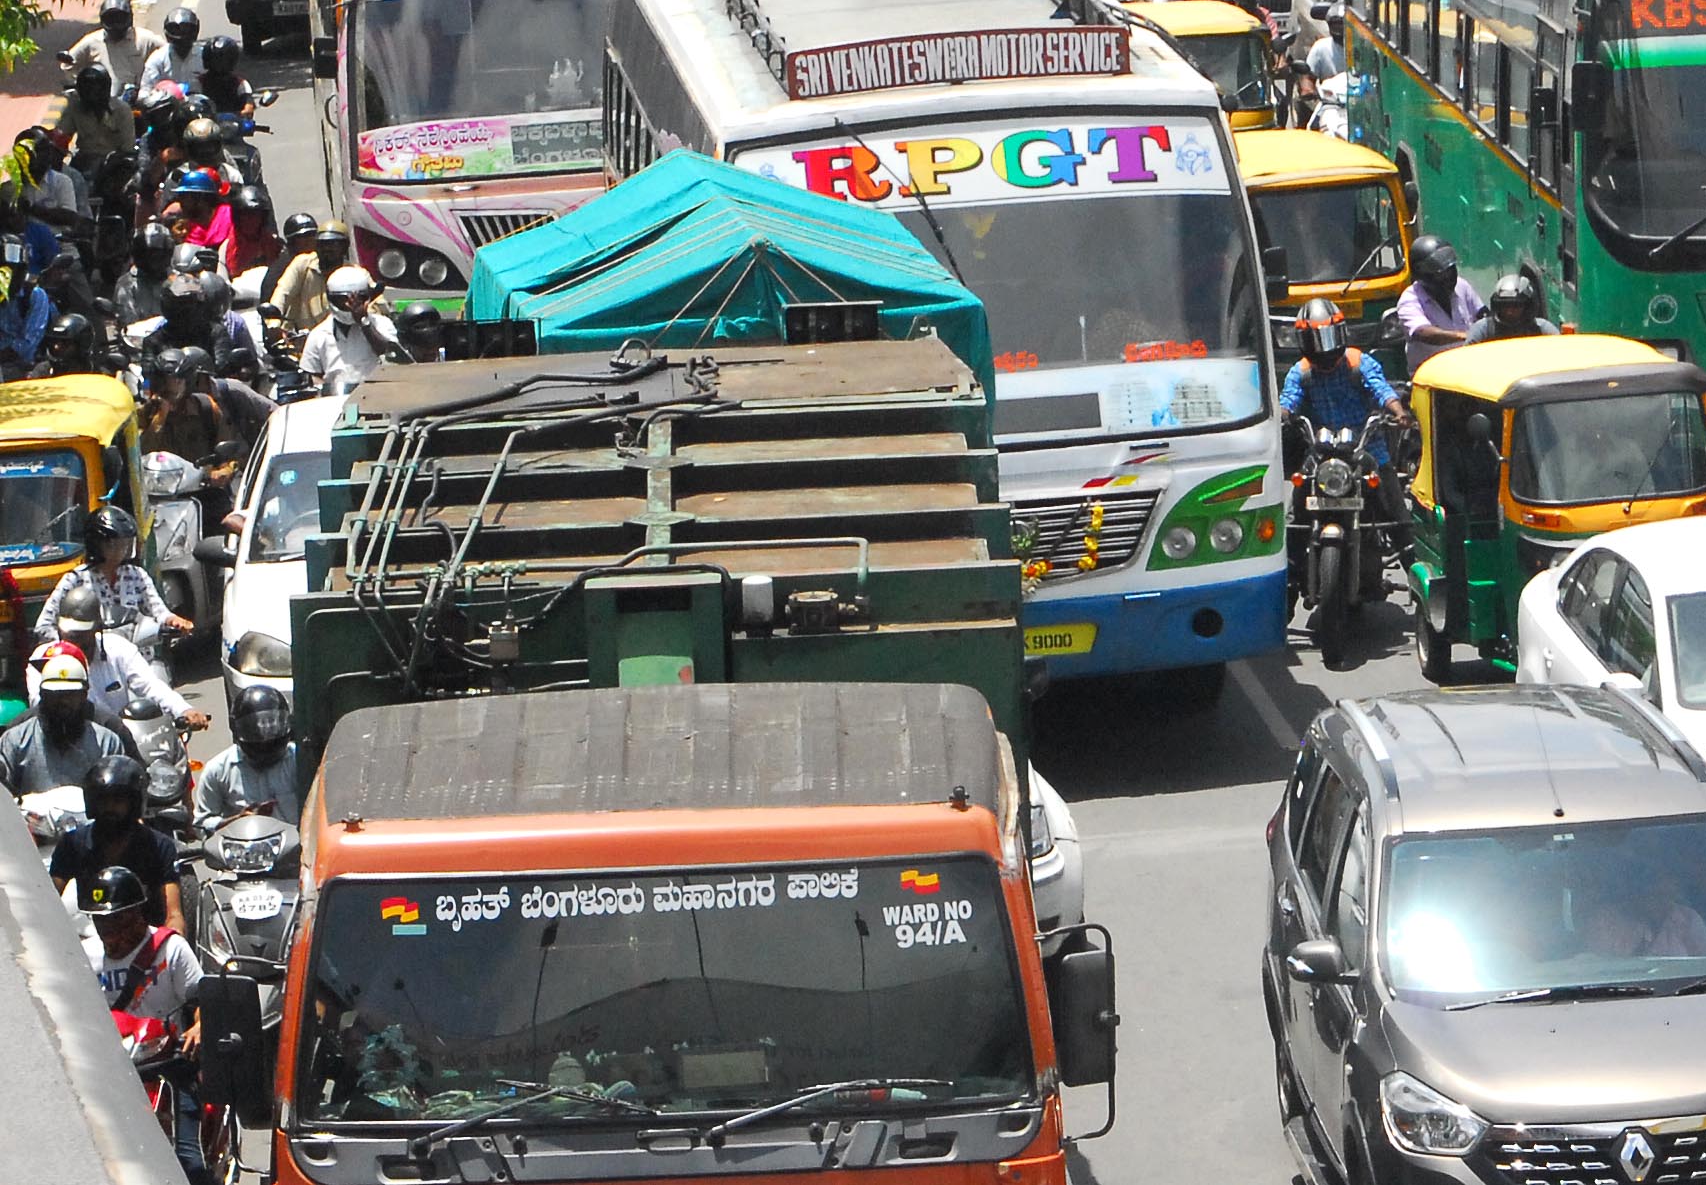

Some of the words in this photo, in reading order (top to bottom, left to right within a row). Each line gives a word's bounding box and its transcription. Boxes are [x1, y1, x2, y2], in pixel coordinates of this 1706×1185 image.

[981, 32, 1044, 78] MOTOR
[1046, 31, 1121, 73] SERVICE
[435, 885, 510, 931] ಬೃಹತ್
[520, 882, 646, 919] ಬೆಂಗಳೂರು
[652, 873, 776, 913] ಮಹಾನಗರ
[786, 868, 860, 899] ಪಾಲಿಕೆ
[883, 903, 940, 926] WARD
[943, 900, 972, 920] NO
[896, 922, 967, 949] 94/A
